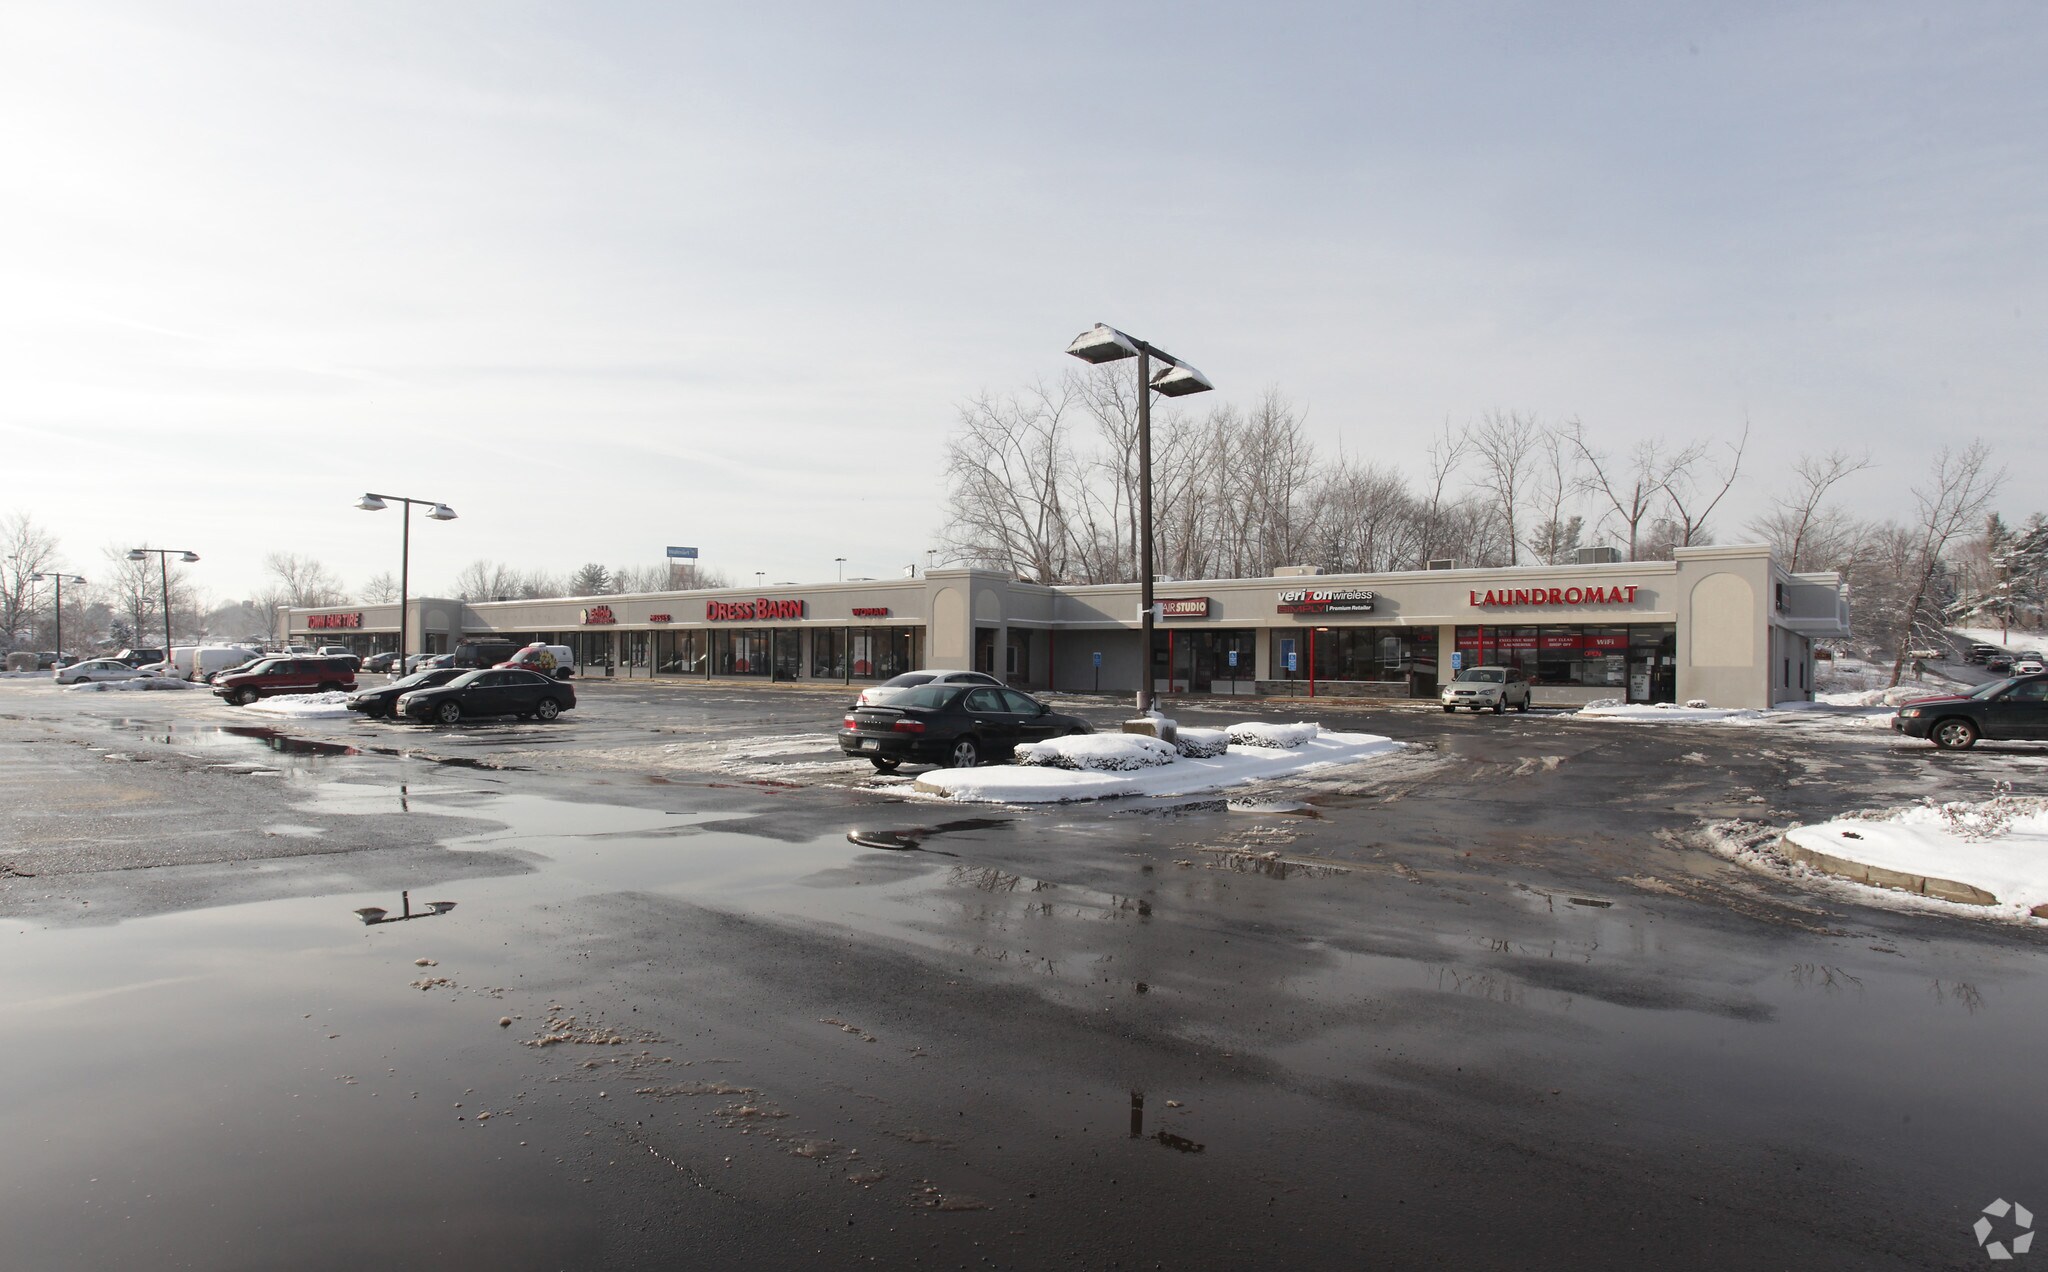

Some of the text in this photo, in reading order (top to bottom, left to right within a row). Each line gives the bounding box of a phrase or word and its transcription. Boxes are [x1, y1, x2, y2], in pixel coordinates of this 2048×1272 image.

[1277, 588, 1373, 603] verizon wireless
[1469, 585, 1638, 607] LAUNDROMAT
[706, 598, 804, 620] DRESS BARN
[851, 607, 888, 616] WOMAN
[1176, 601, 1207, 613] STUDIO
[1278, 605, 1325, 613] SIMPLY
[306, 612, 362, 629] TOWN FAIR TIRE
